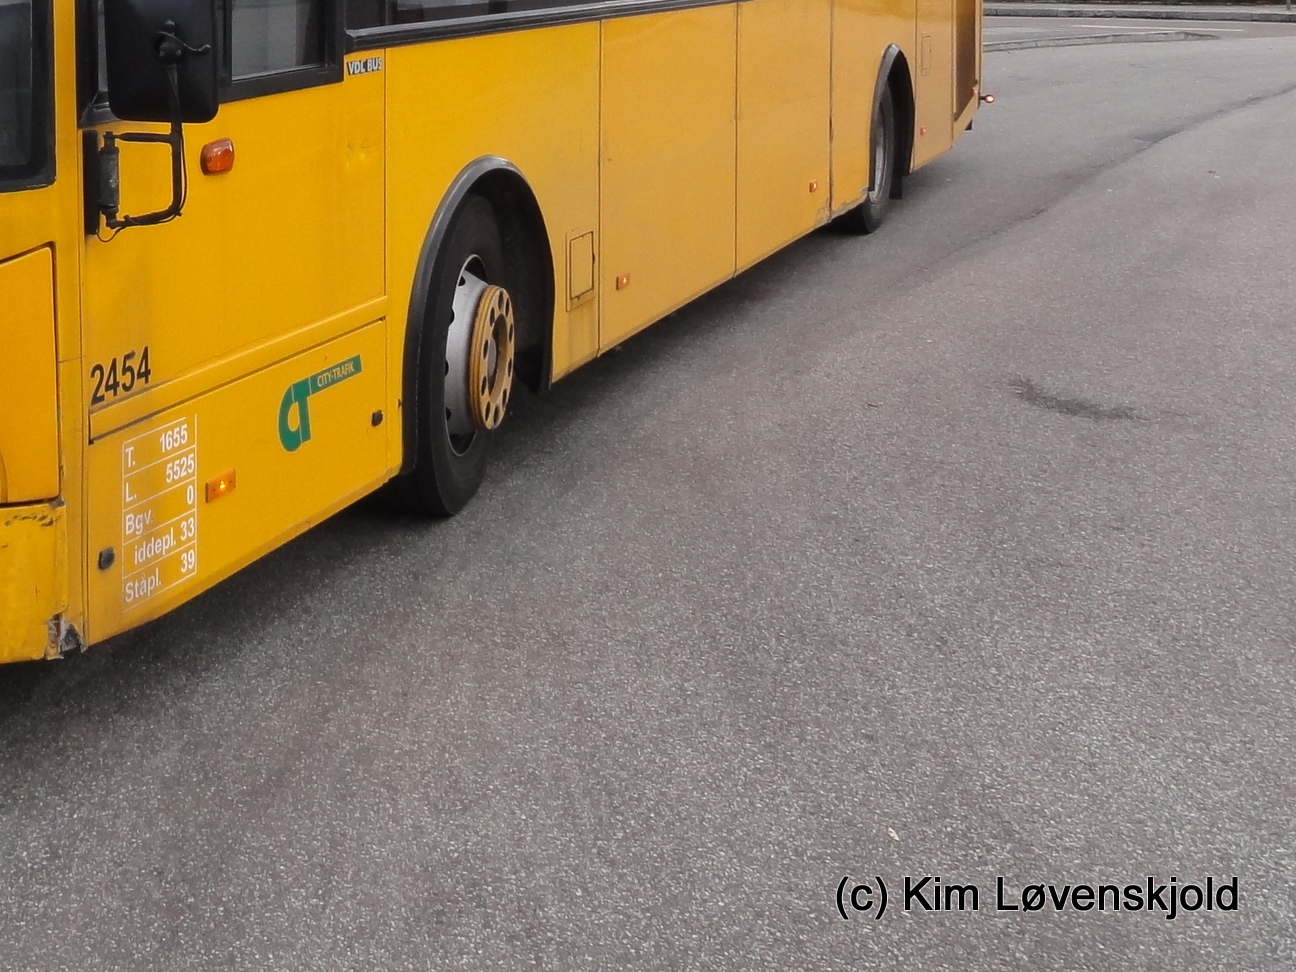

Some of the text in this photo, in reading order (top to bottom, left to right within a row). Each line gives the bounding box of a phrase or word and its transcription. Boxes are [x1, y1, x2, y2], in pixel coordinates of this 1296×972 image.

[348, 60, 365, 75] VDL
[90, 346, 151, 406] 2454
[125, 424, 188, 468] T. 1655
[125, 453, 195, 502] L. 5525
[180, 517, 195, 541] 33
[180, 549, 195, 573] 39
